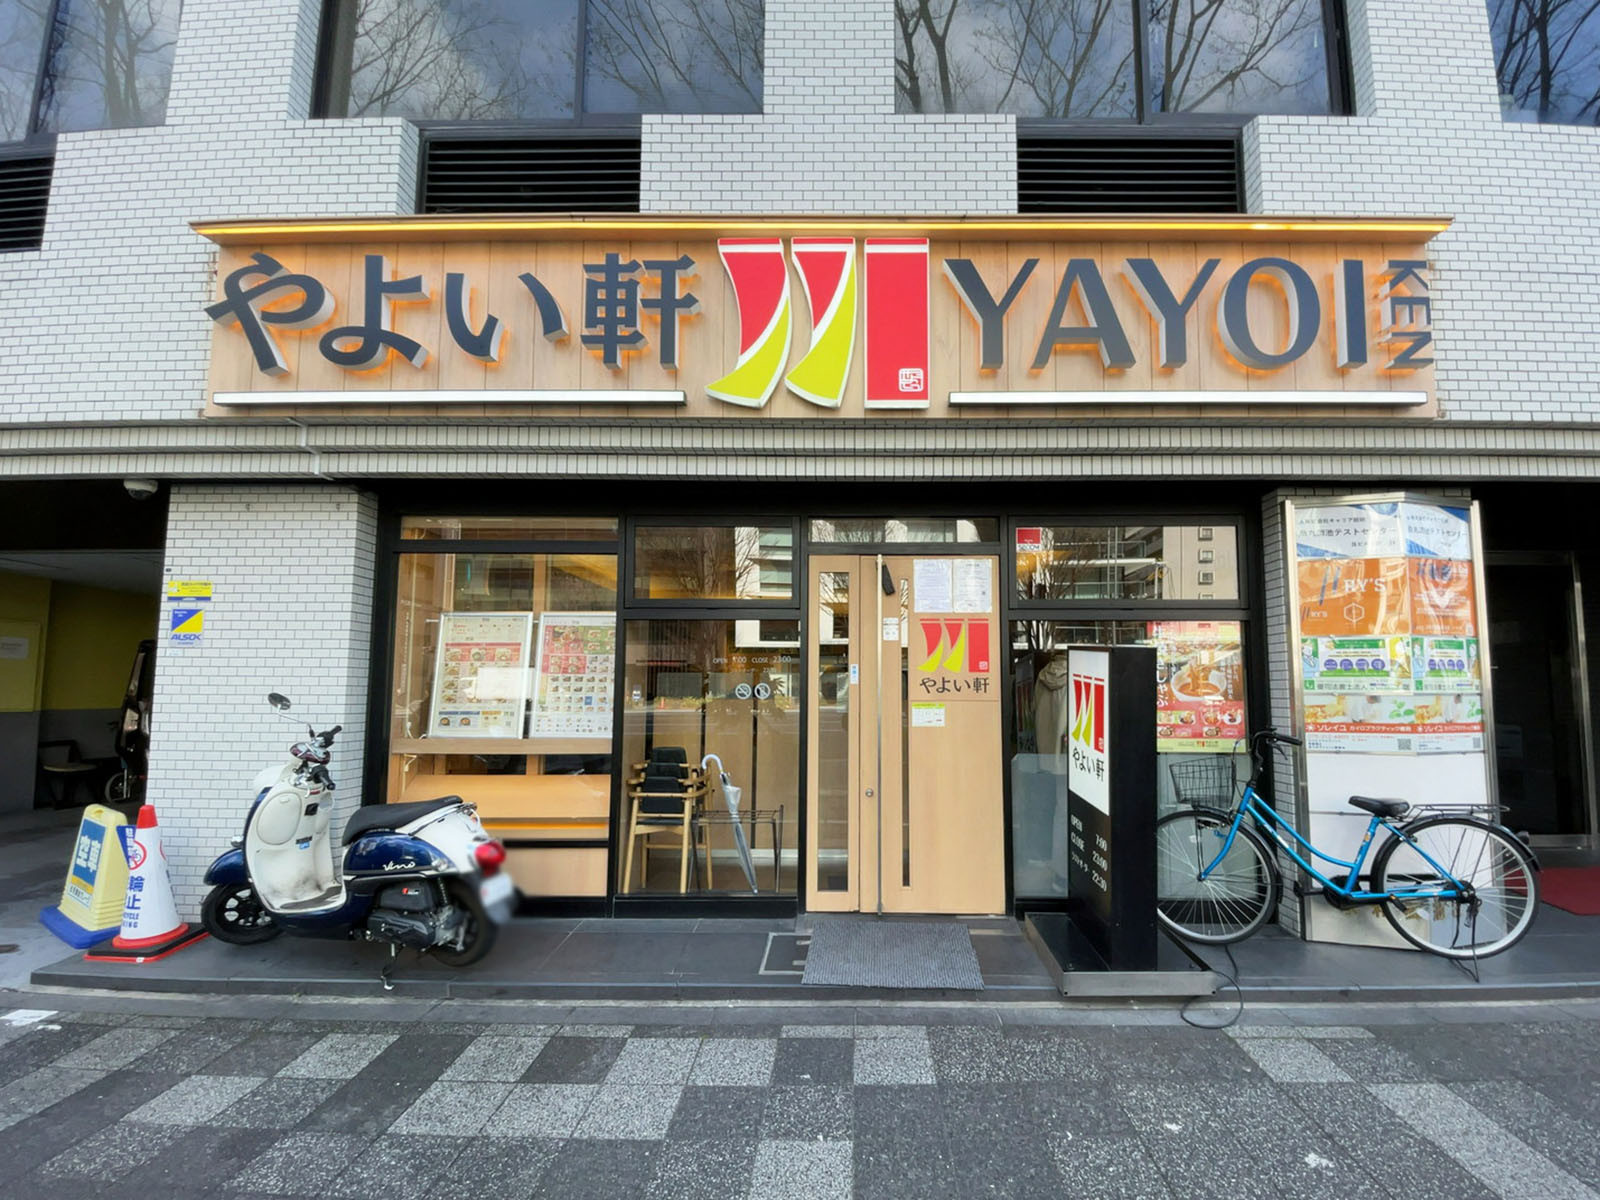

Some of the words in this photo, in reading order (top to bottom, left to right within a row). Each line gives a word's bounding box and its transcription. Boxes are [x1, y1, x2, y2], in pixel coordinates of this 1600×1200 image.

[204, 252, 698, 376] やよい軒
[943, 258, 1369, 370] YAYOI
[1387, 260, 1434, 369] KEN
[171, 633, 201, 641] ALSOK
[919, 676, 990, 694] やよい軒
[1072, 747, 1105, 782] やよい軒
[382, 860, 416, 872] Vino
